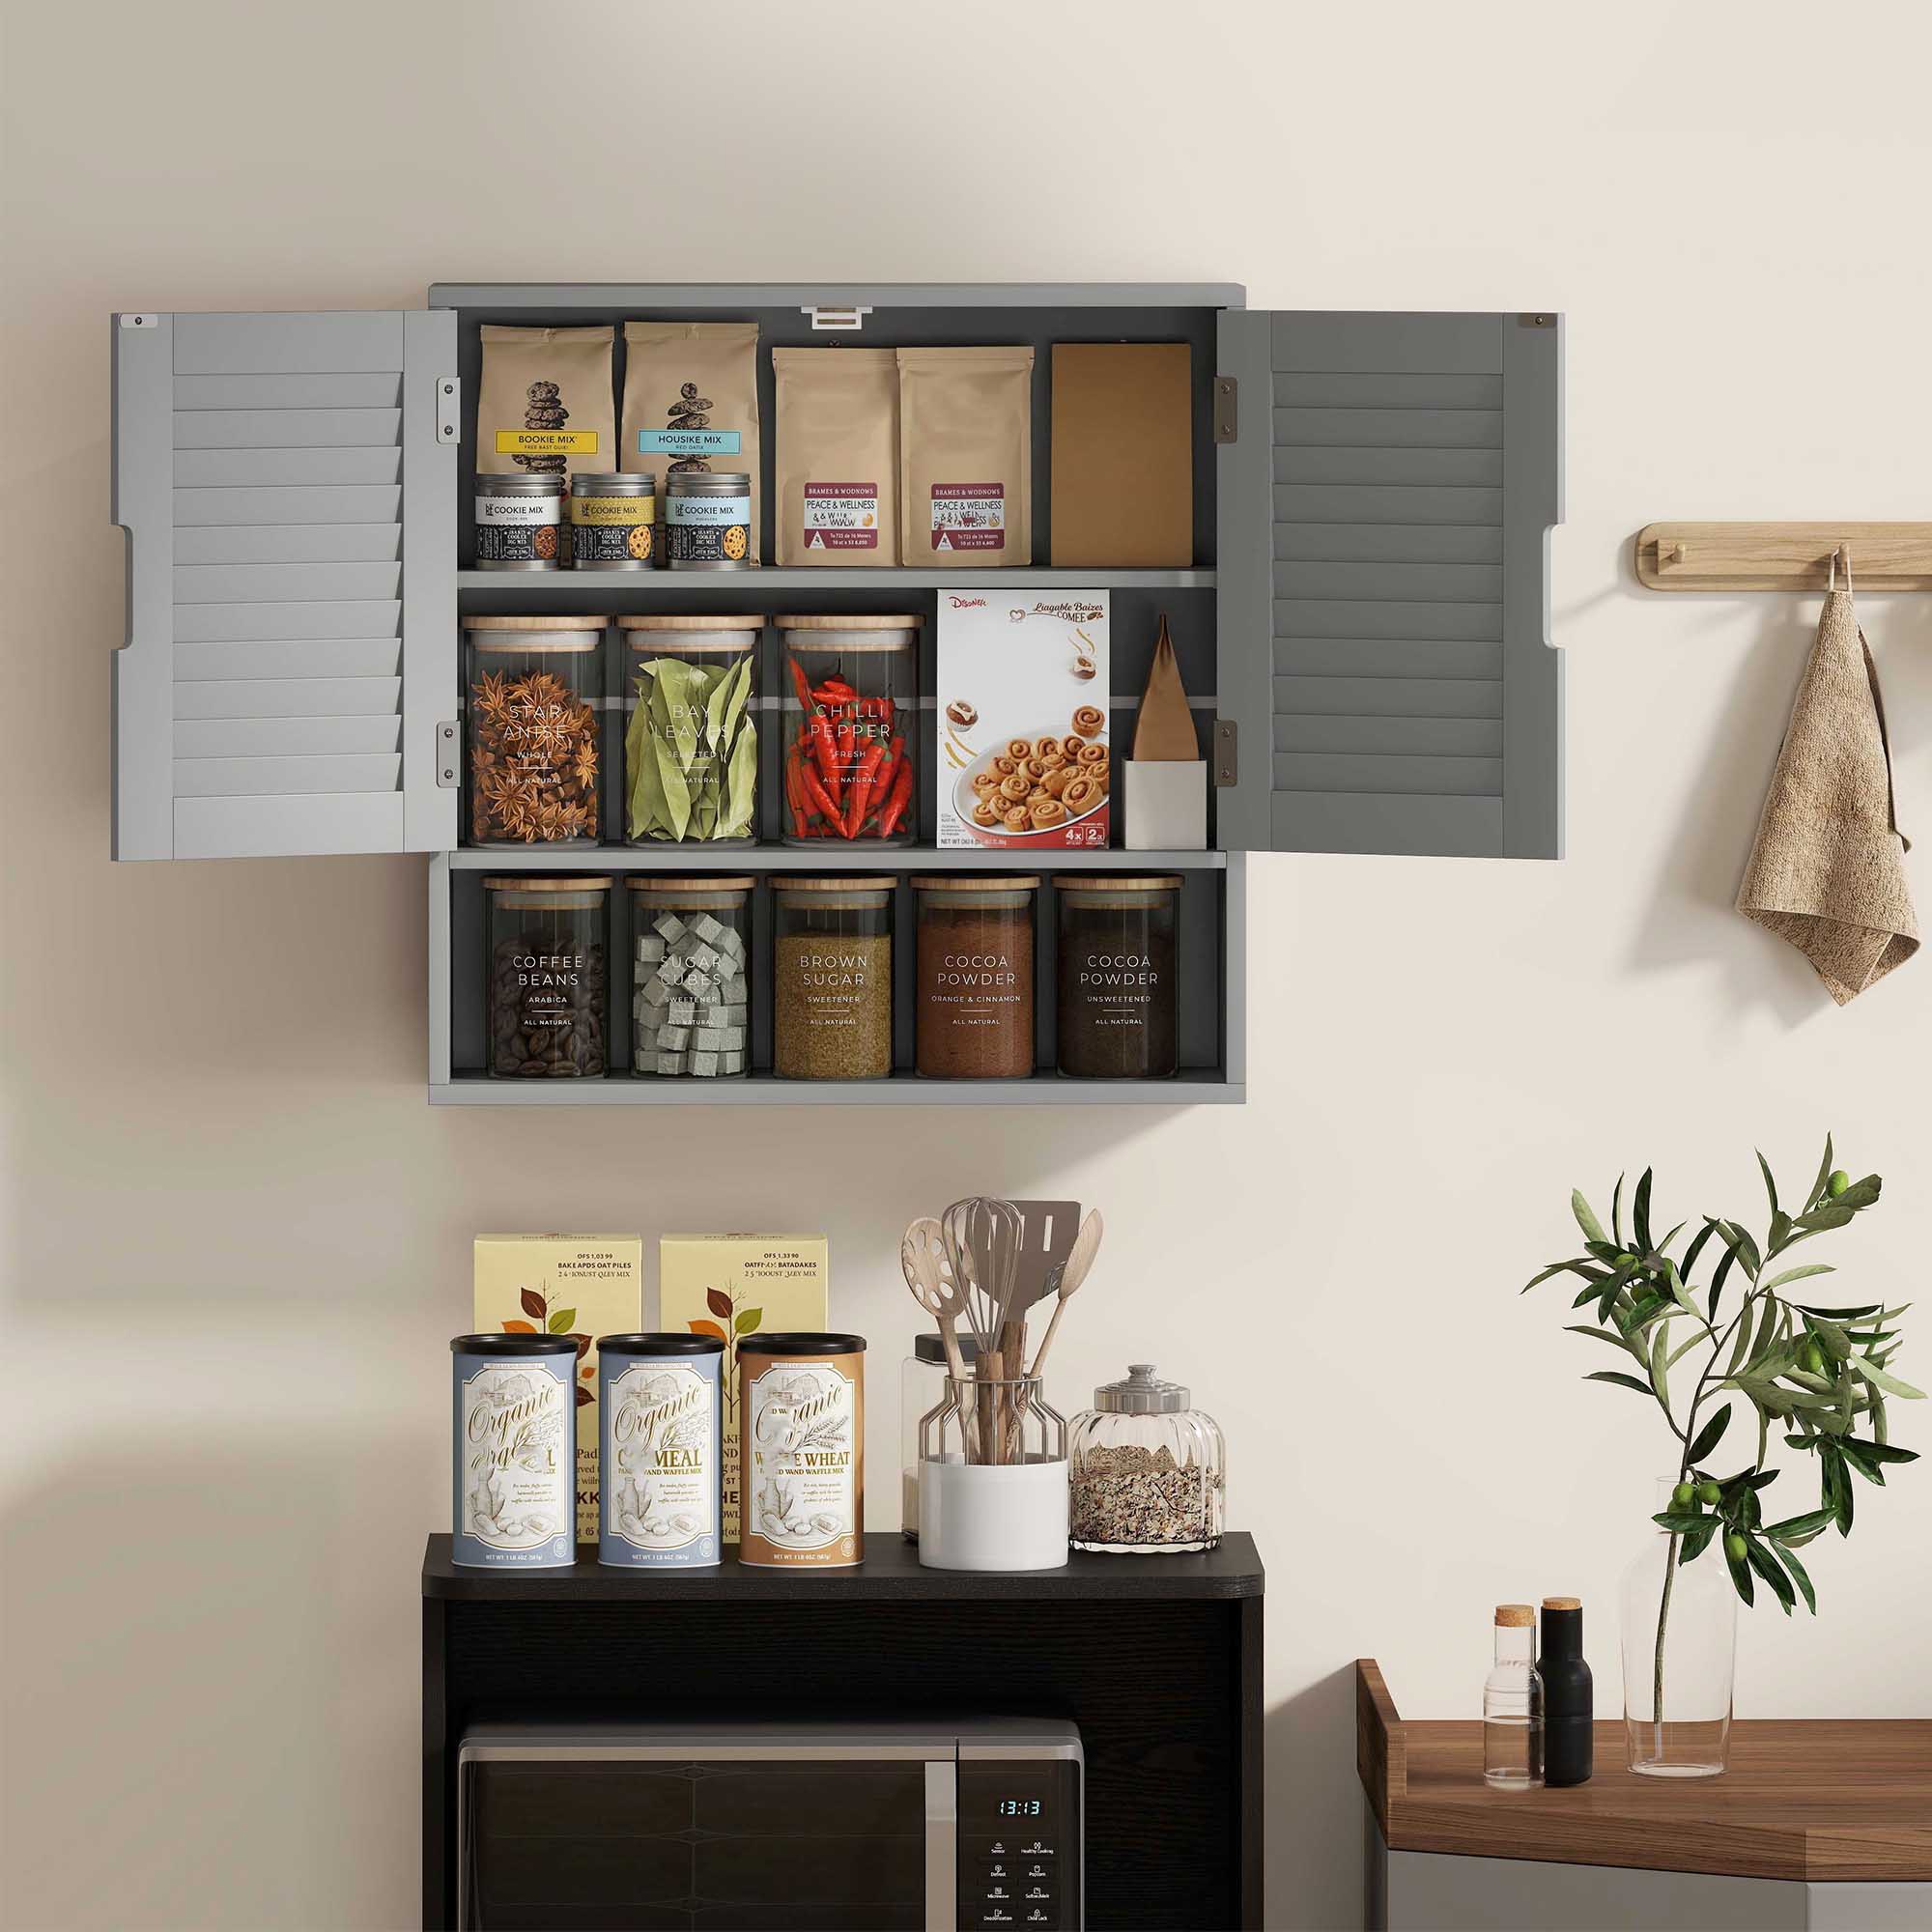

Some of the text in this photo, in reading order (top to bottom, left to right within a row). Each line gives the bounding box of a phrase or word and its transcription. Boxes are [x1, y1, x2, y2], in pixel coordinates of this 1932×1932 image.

[807, 500, 875, 509] PEACE & WELLNESS
[933, 500, 1002, 510] PEACE & WELLNESS
[510, 705, 560, 719] STAR
[673, 705, 711, 718] BAY
[816, 704, 883, 718] CHILLI
[811, 724, 890, 738] PEPPER
[513, 955, 582, 968] COFFEE
[661, 955, 721, 968] SUGAR
[800, 955, 867, 968] BROWN
[945, 955, 1009, 968] COCOA
[1087, 955, 1151, 968] COCOA
[518, 973, 579, 986] BEANS
[661, 973, 721, 986] CUBES
[803, 973, 865, 985] SUGAR
[937, 973, 1015, 985] POWDER
[1080, 973, 1158, 985] POWDER
[469, 1384, 554, 1446] Organic
[615, 1383, 701, 1452] Organic
[804, 1451, 850, 1466] WHEAT
[1000, 1801, 1040, 1814] 13:13
